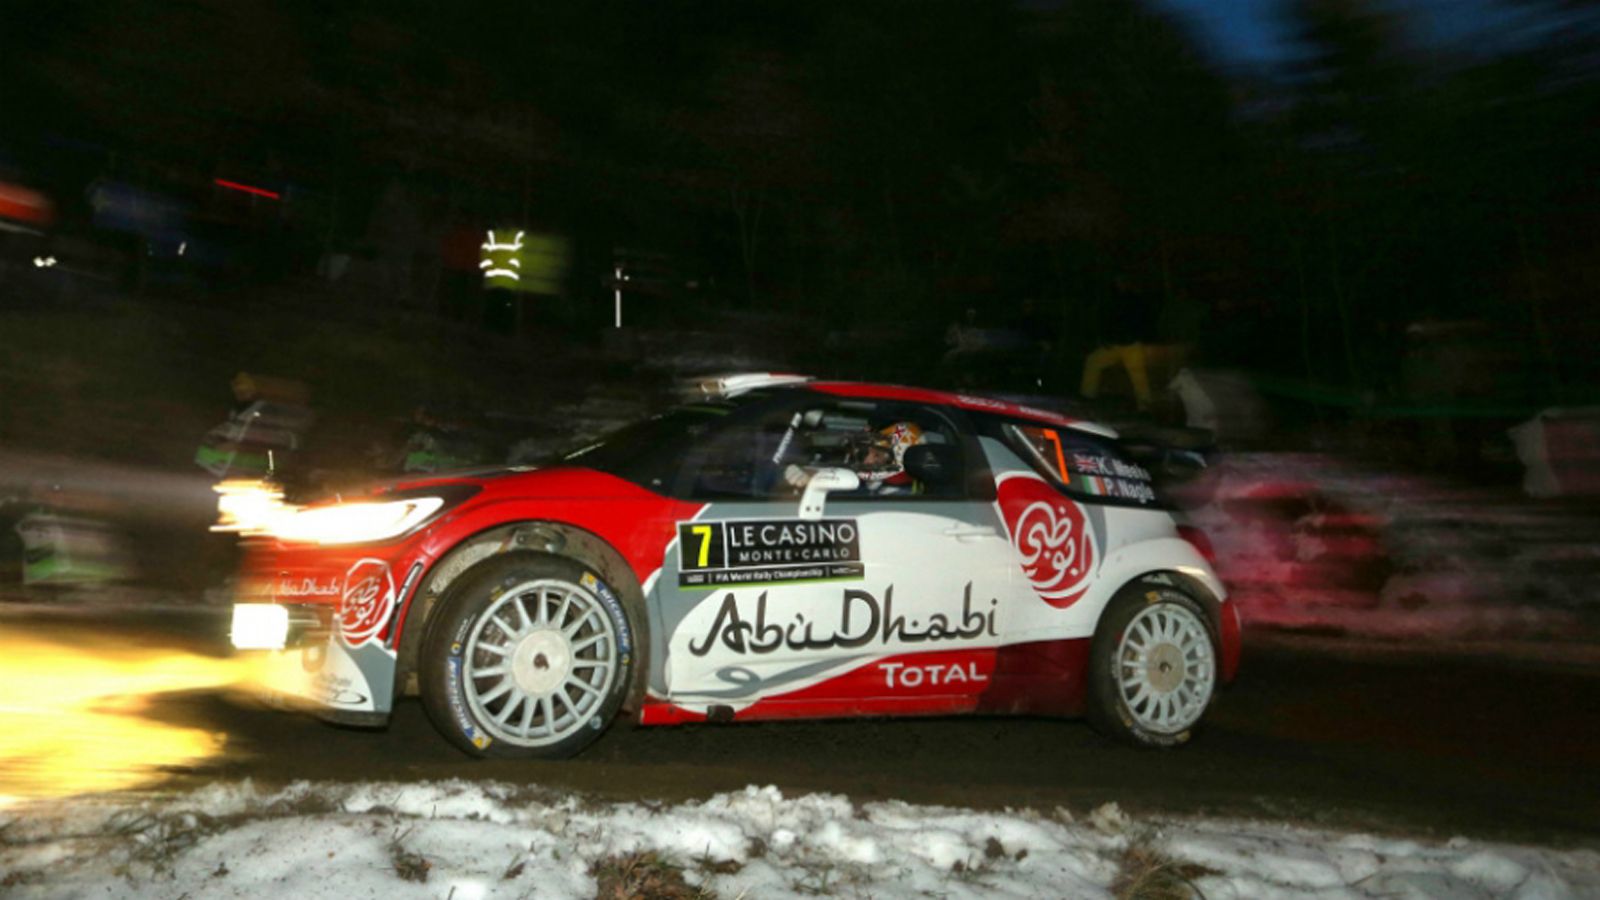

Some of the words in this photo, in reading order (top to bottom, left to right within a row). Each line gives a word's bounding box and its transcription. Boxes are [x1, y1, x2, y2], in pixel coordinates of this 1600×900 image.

[1043, 429, 1071, 485] 7
[1118, 479, 1156, 504] Nagle
[692, 525, 712, 567] 7
[730, 527, 755, 547] LE
[761, 523, 856, 546] CASINO
[730, 572, 752, 581] World
